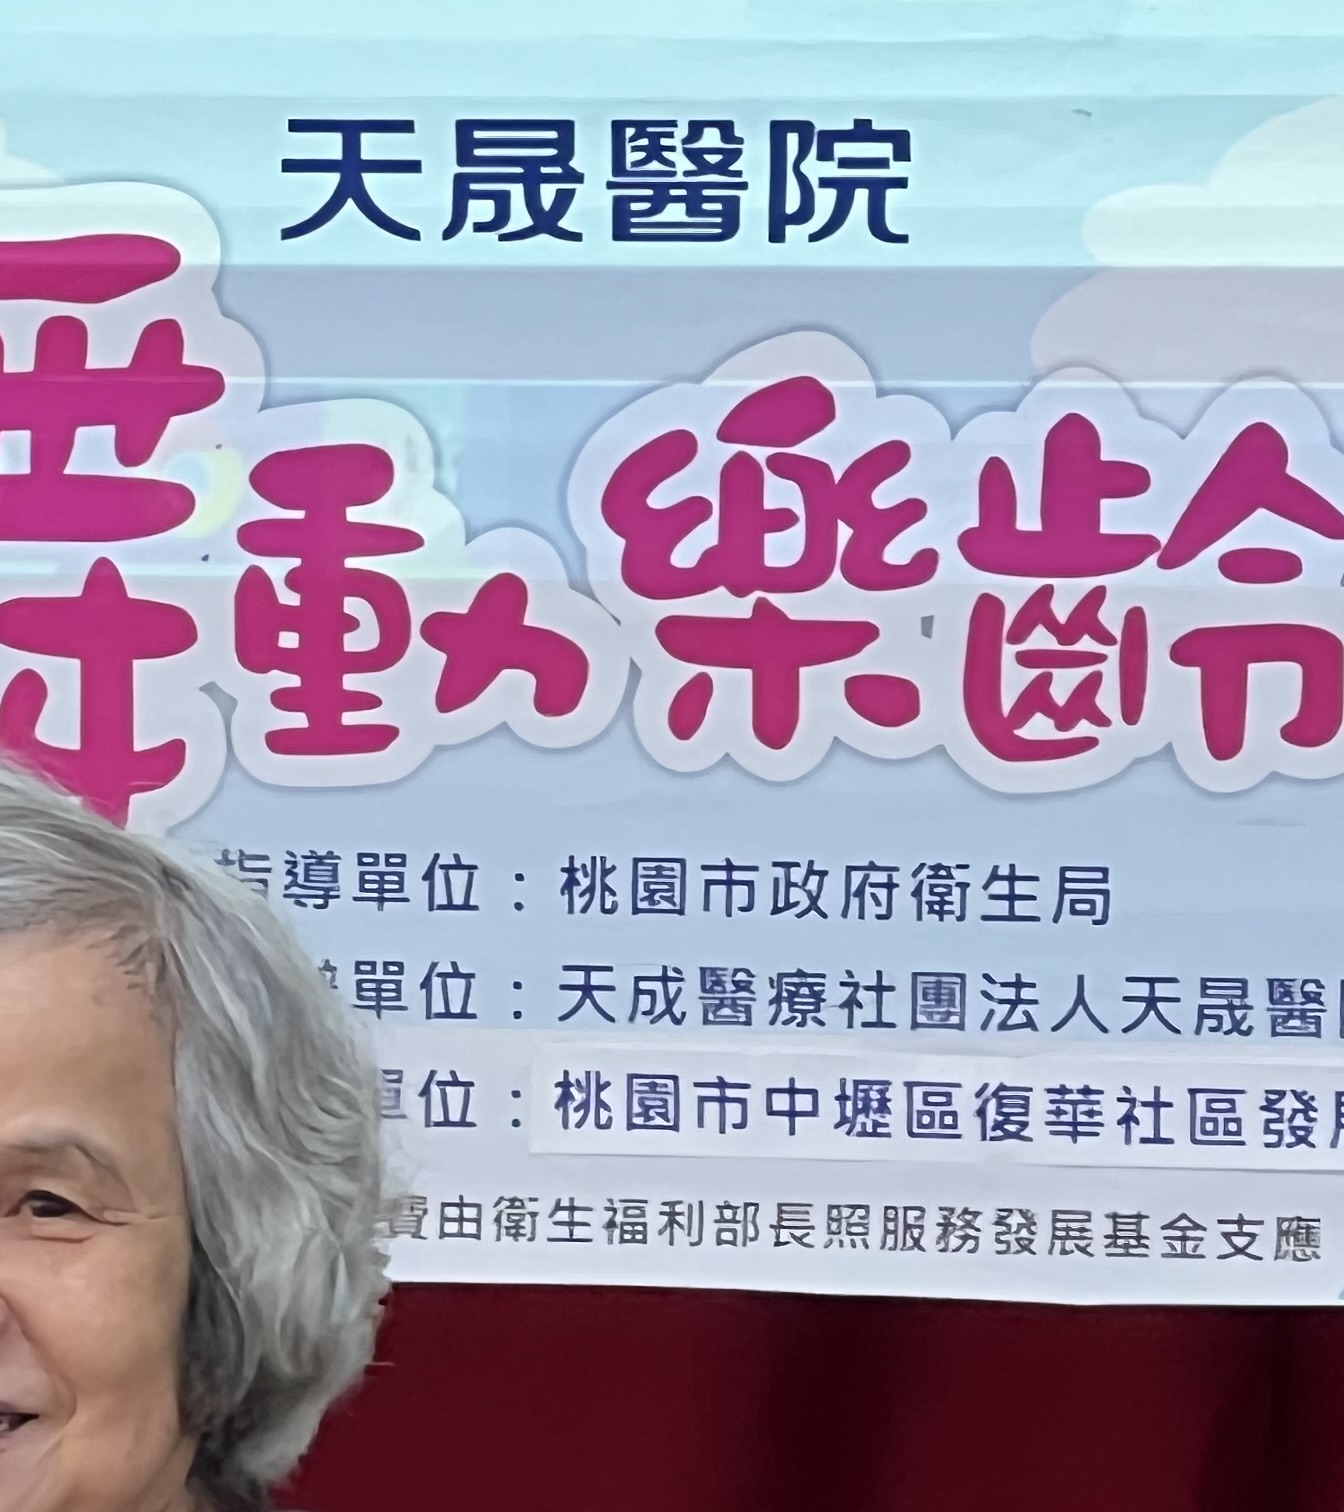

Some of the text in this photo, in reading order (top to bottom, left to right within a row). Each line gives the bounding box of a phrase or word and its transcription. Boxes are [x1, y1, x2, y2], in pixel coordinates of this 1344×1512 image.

[279, 117, 914, 245] 天晟醫院
[317, 958, 1344, 1040] 單位：天成醫療社團法人天晟醫
